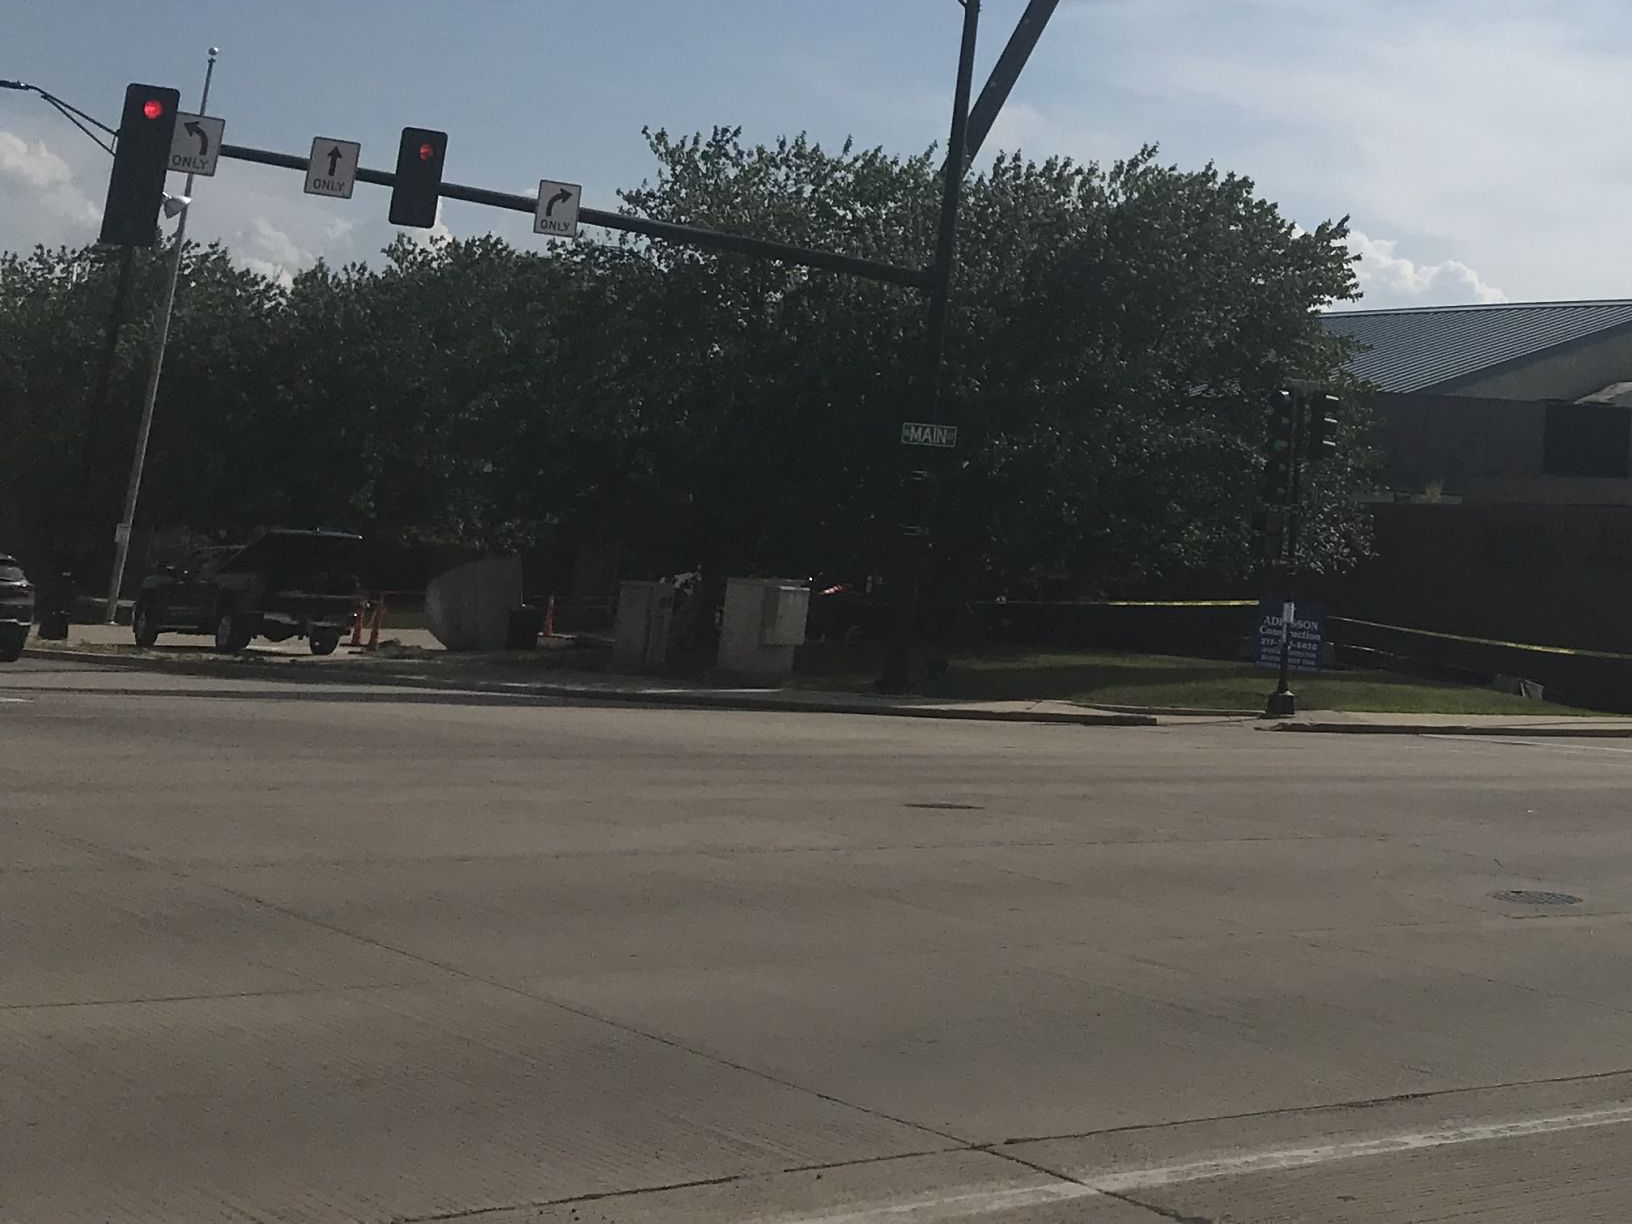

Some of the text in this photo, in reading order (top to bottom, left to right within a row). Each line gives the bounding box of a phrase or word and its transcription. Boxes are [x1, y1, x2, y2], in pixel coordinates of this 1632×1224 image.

[173, 155, 209, 170] ONLY
[313, 178, 345, 192] ONLY
[540, 219, 570, 231] ONLY
[910, 425, 947, 444] MAIN
